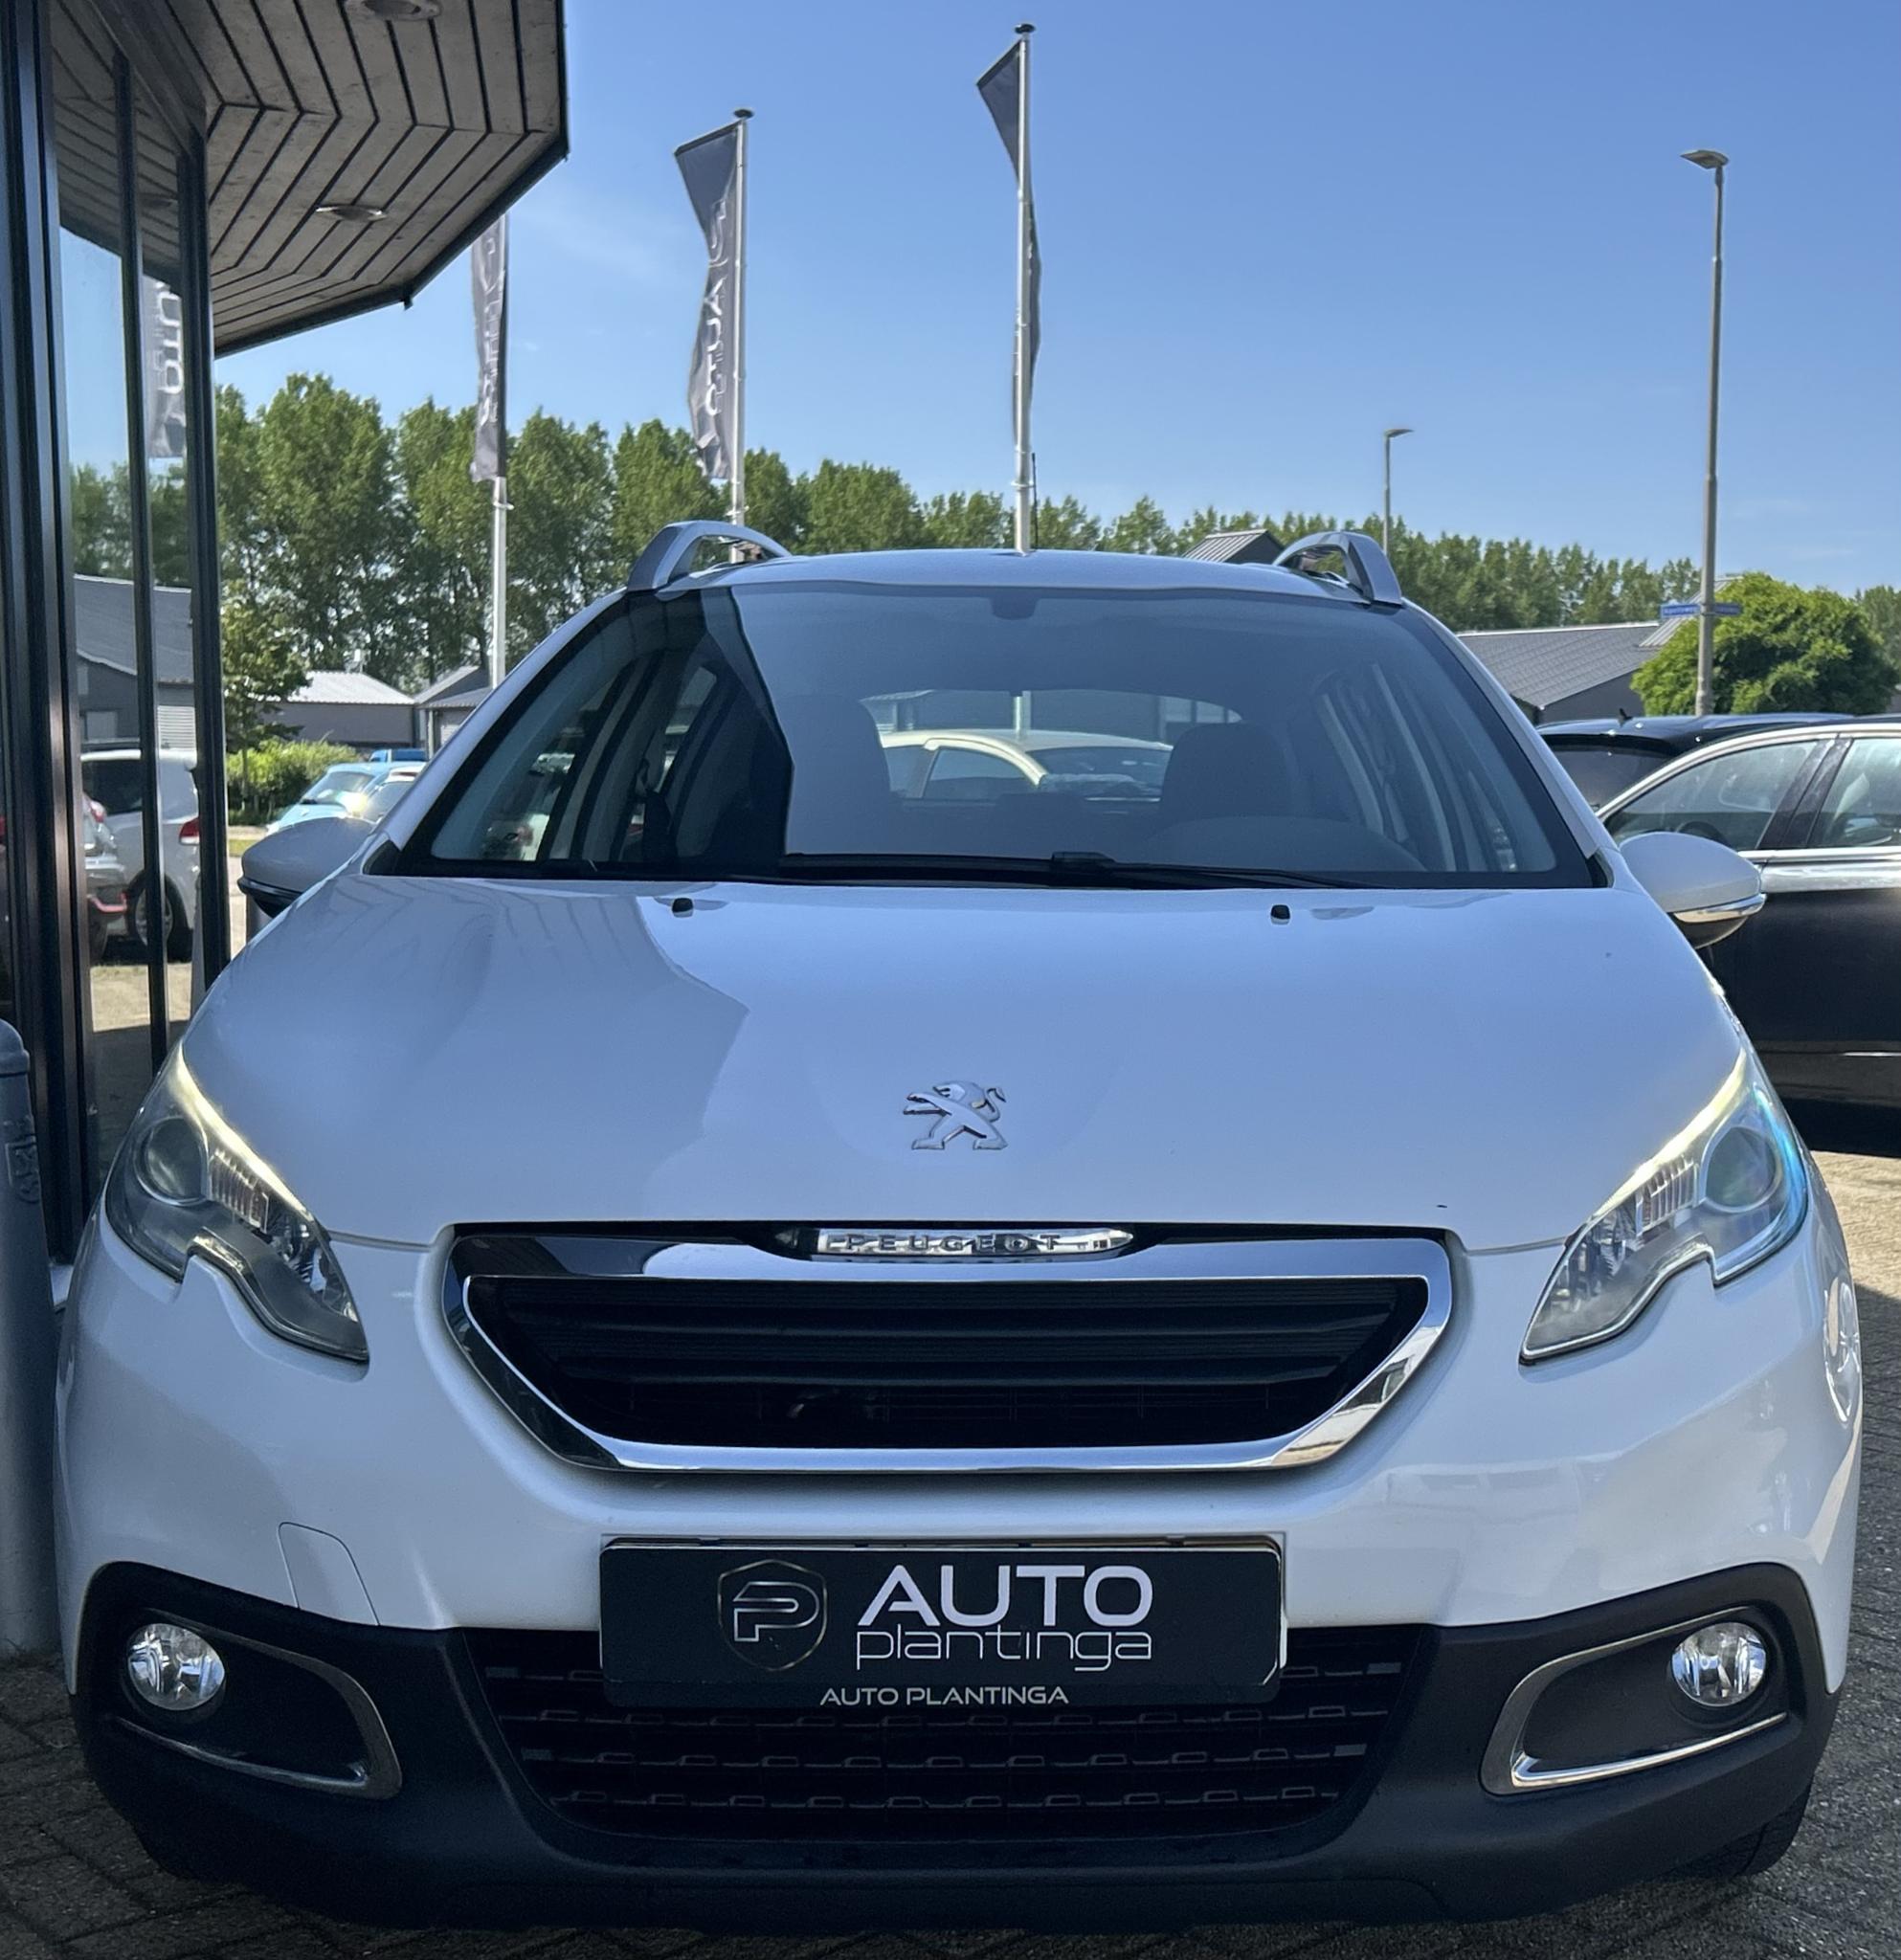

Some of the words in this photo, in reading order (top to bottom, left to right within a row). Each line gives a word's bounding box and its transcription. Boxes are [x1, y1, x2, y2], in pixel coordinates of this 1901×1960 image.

[844, 1233, 1062, 1254] PEUGEOT
[858, 1565, 1153, 1627] AUTO
[857, 1625, 1152, 1672] plantinga
[819, 1687, 899, 1705] AUTO
[906, 1686, 1069, 1705] PLANTINGA
